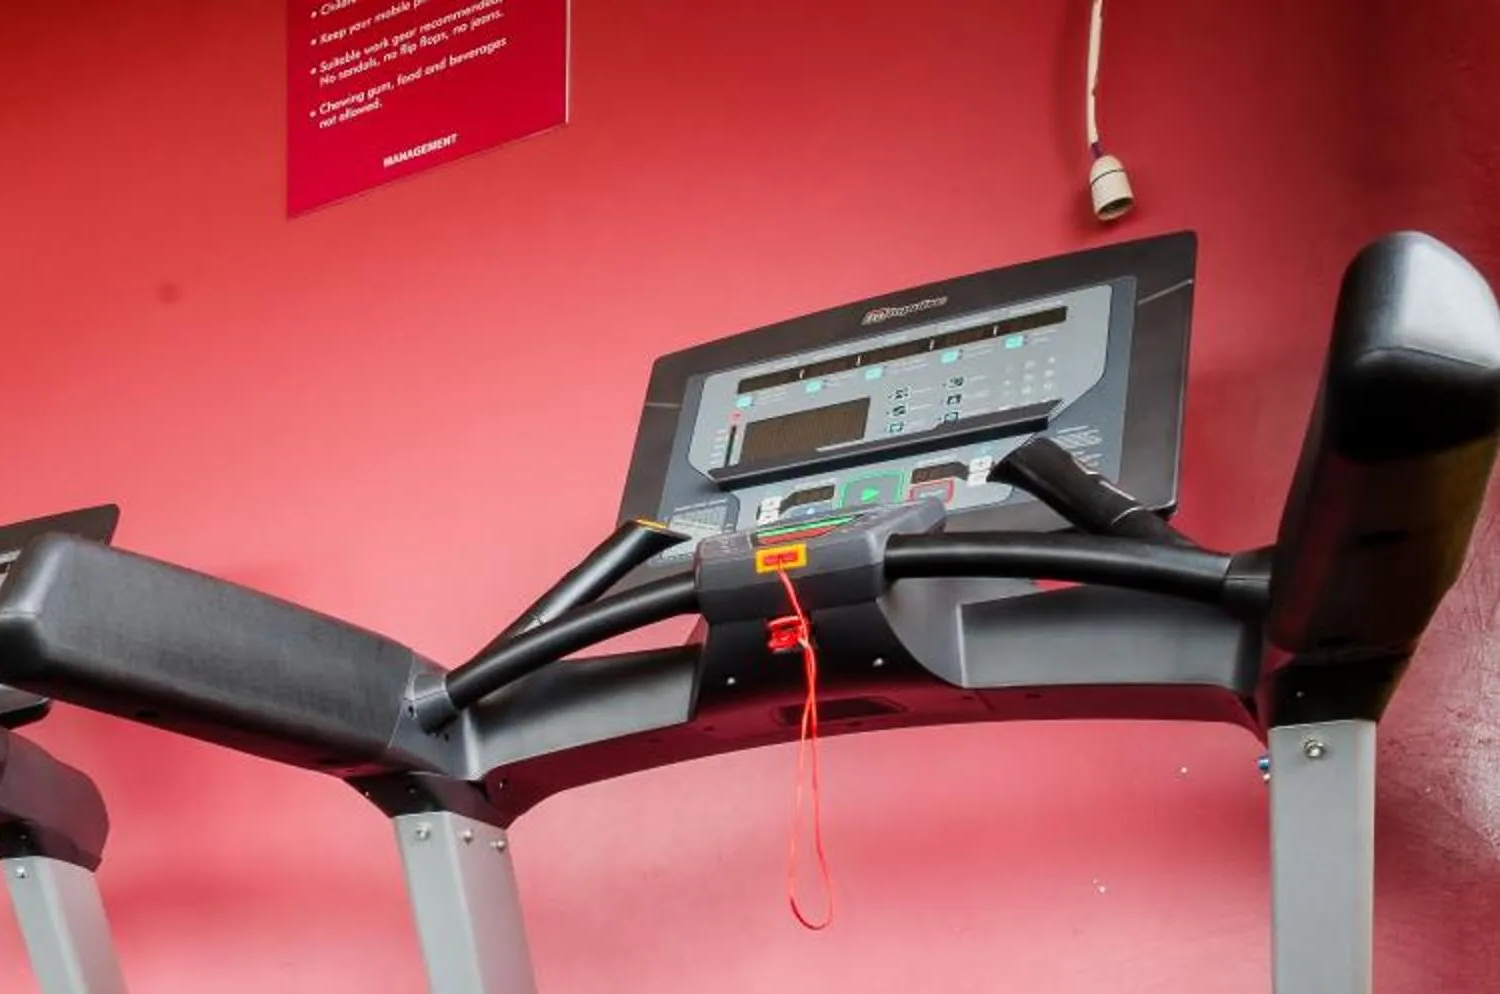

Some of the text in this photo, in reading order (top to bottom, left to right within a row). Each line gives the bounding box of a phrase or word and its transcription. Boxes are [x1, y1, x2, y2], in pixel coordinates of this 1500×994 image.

[320, 28, 347, 44] Keep
[349, 18, 372, 35] your
[374, 1, 410, 23] mobile
[320, 49, 361, 72] Suitable
[363, 37, 389, 54] work
[392, 26, 417, 46] gear
[320, 74, 337, 87] No
[383, 50, 399, 63] no
[400, 43, 417, 56] flip
[452, 22, 468, 35] no
[319, 92, 365, 114] Chewing
[397, 66, 422, 86] food
[424, 56, 447, 76] and
[448, 37, 507, 67] beverages
[319, 115, 337, 129] not
[383, 132, 457, 169] MANAGEMENT
